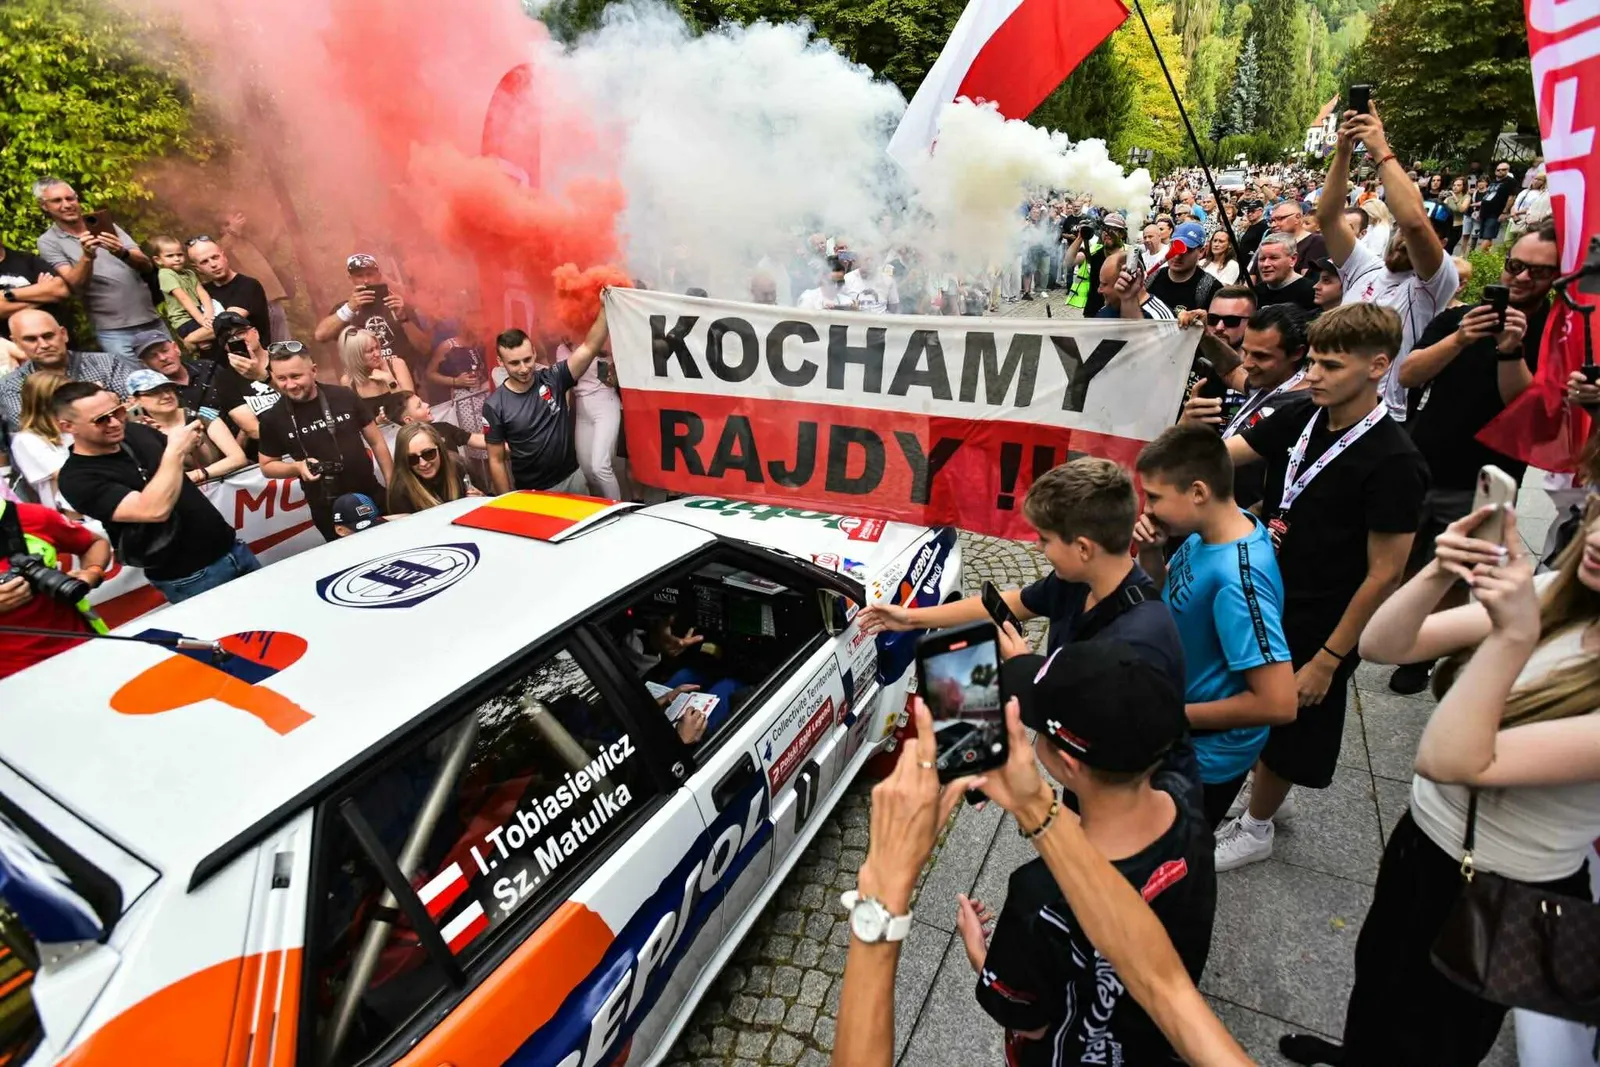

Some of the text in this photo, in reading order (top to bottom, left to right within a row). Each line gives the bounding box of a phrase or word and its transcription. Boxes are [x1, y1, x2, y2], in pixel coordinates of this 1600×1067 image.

[649, 315, 1128, 412] KOCHAMY
[288, 413, 351, 439] RCHMND
[659, 409, 963, 506] RAJDY
[911, 544, 934, 586] REPSOL
[1247, 593, 1260, 618] YOUR
[772, 696, 807, 742] Collectivité
[807, 662, 838, 700] Territoriale
[772, 767, 781, 785] 2
[780, 742, 798, 773] Polski
[812, 701, 832, 732] Legend
[797, 694, 825, 729] de Corse
[493, 783, 632, 911] Sz. Matulka
[557, 785, 766, 1067] EPSOL
